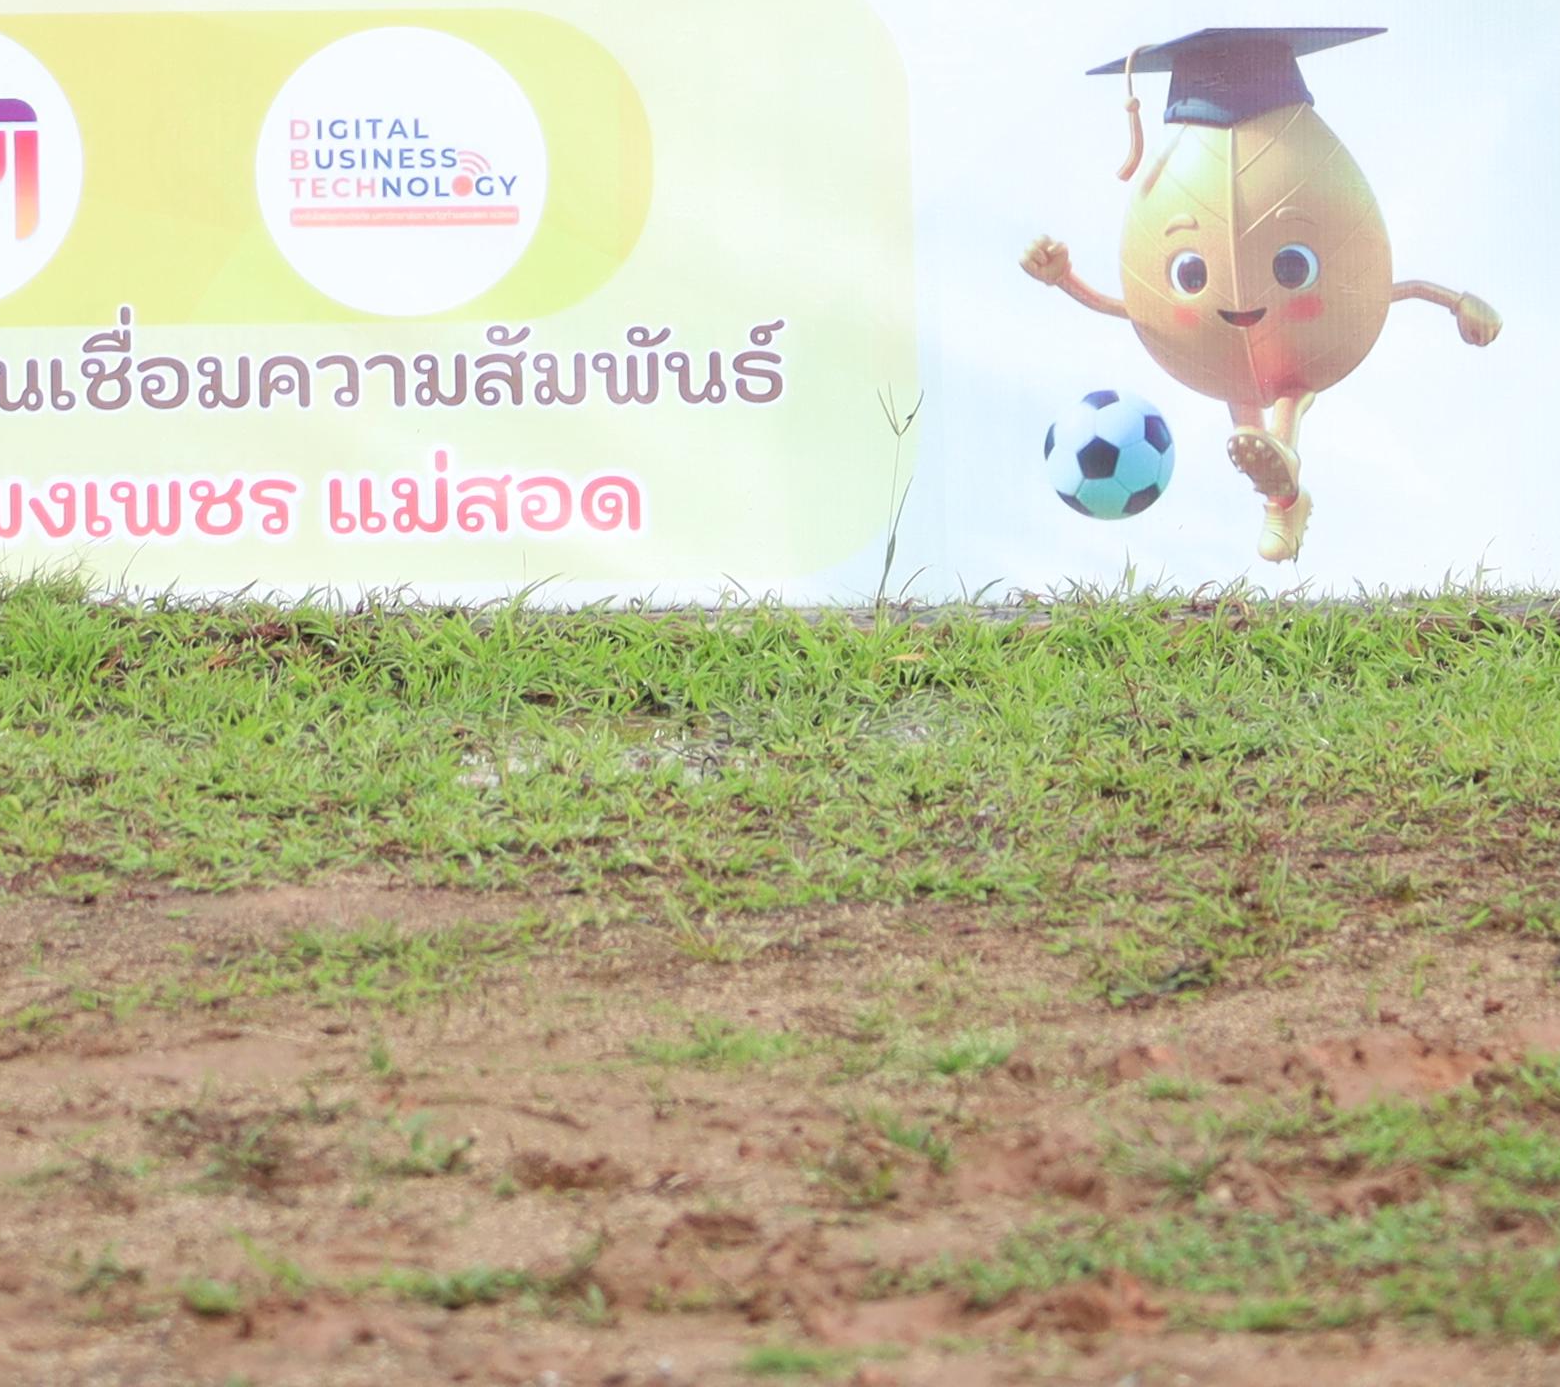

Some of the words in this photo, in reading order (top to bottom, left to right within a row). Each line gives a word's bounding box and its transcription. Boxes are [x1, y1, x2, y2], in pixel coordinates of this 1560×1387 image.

[289, 118, 430, 141] DIGITAL
[289, 148, 458, 171] BUSINESS
[329, 449, 643, 534] แม่สอด
